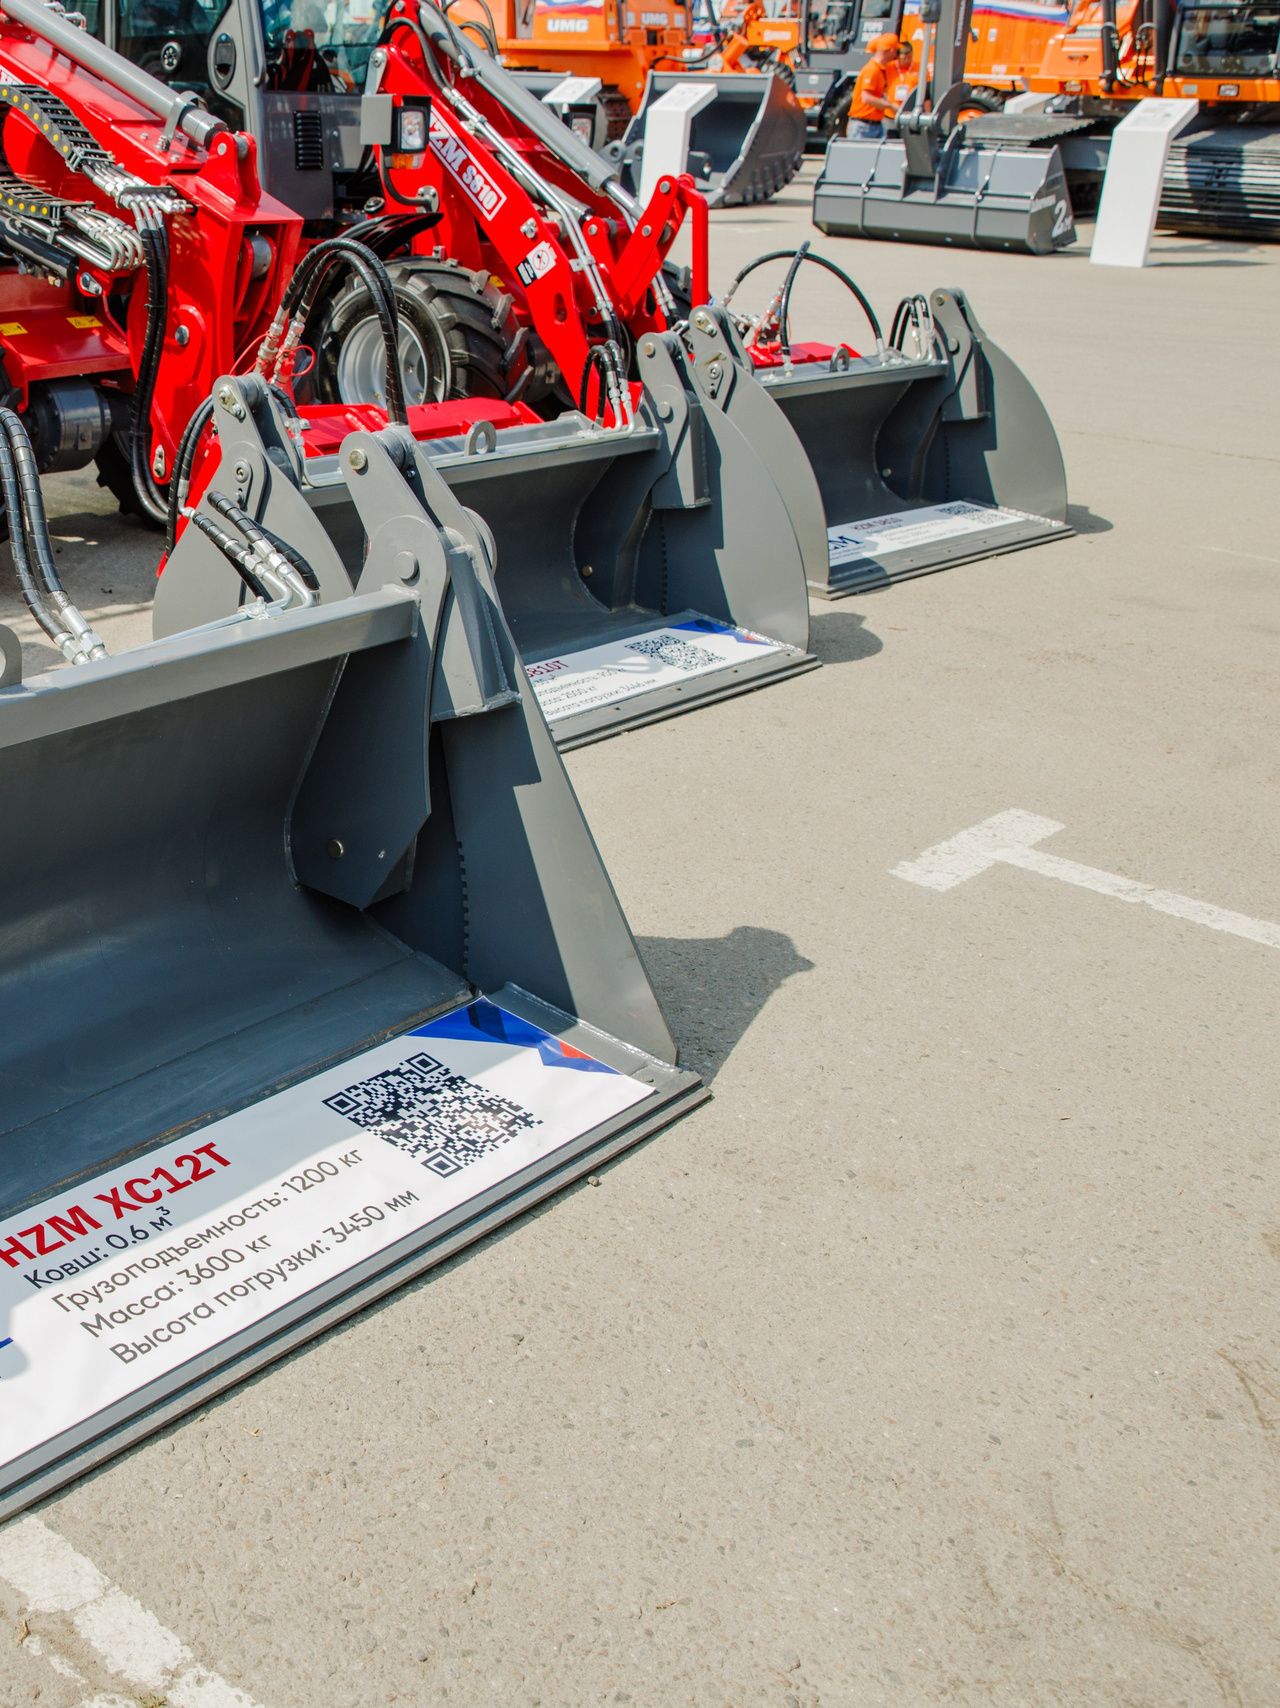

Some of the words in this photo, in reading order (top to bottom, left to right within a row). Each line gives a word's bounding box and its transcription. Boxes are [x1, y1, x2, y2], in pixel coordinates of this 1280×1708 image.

[547, 19, 589, 32] UMG
[641, 12, 668, 26] UMG
[462, 165, 499, 211] S810
[94, 1142, 231, 1220] XC12T
[23, 1246, 109, 1289] Ковш:
[105, 1225, 149, 1250] 0.6
[51, 1192, 289, 1312] Грузоподъемность:
[281, 1161, 339, 1196] 1200
[338, 1149, 363, 1168] кг
[80, 1281, 177, 1338] Масса:
[176, 1248, 246, 1285] 3600
[244, 1234, 272, 1254] кг
[109, 1302, 215, 1364] Высота
[214, 1240, 331, 1307] погрузки:
[323, 1205, 386, 1243] 3450
[383, 1190, 421, 1213] мм
